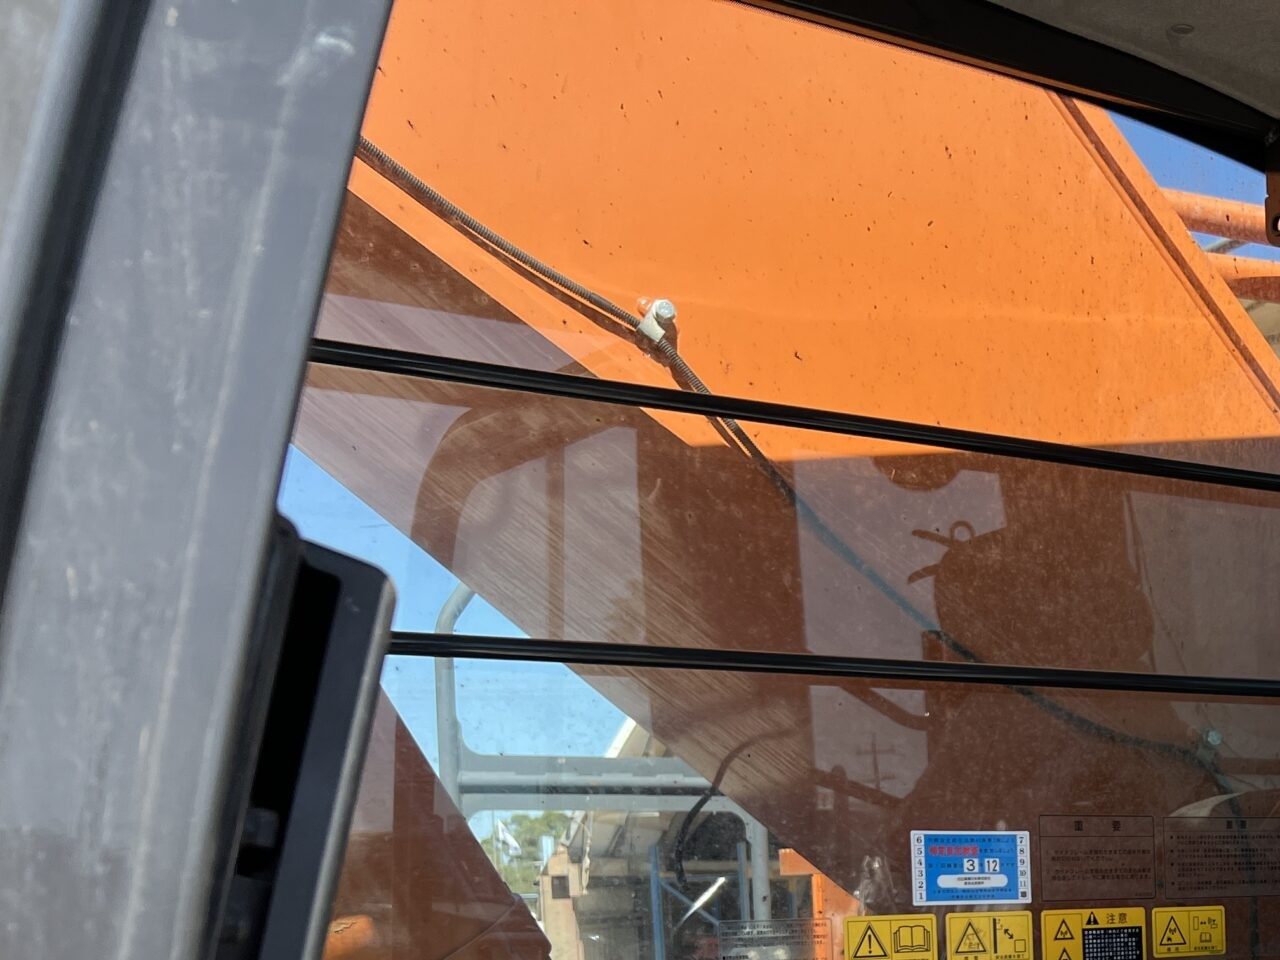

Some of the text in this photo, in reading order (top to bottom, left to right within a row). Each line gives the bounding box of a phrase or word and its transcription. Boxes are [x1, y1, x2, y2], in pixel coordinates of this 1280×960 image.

[916, 836, 922, 844] 6
[966, 860, 975, 871] 3
[986, 860, 998, 872] 12
[1106, 912, 1128, 924] 注意
